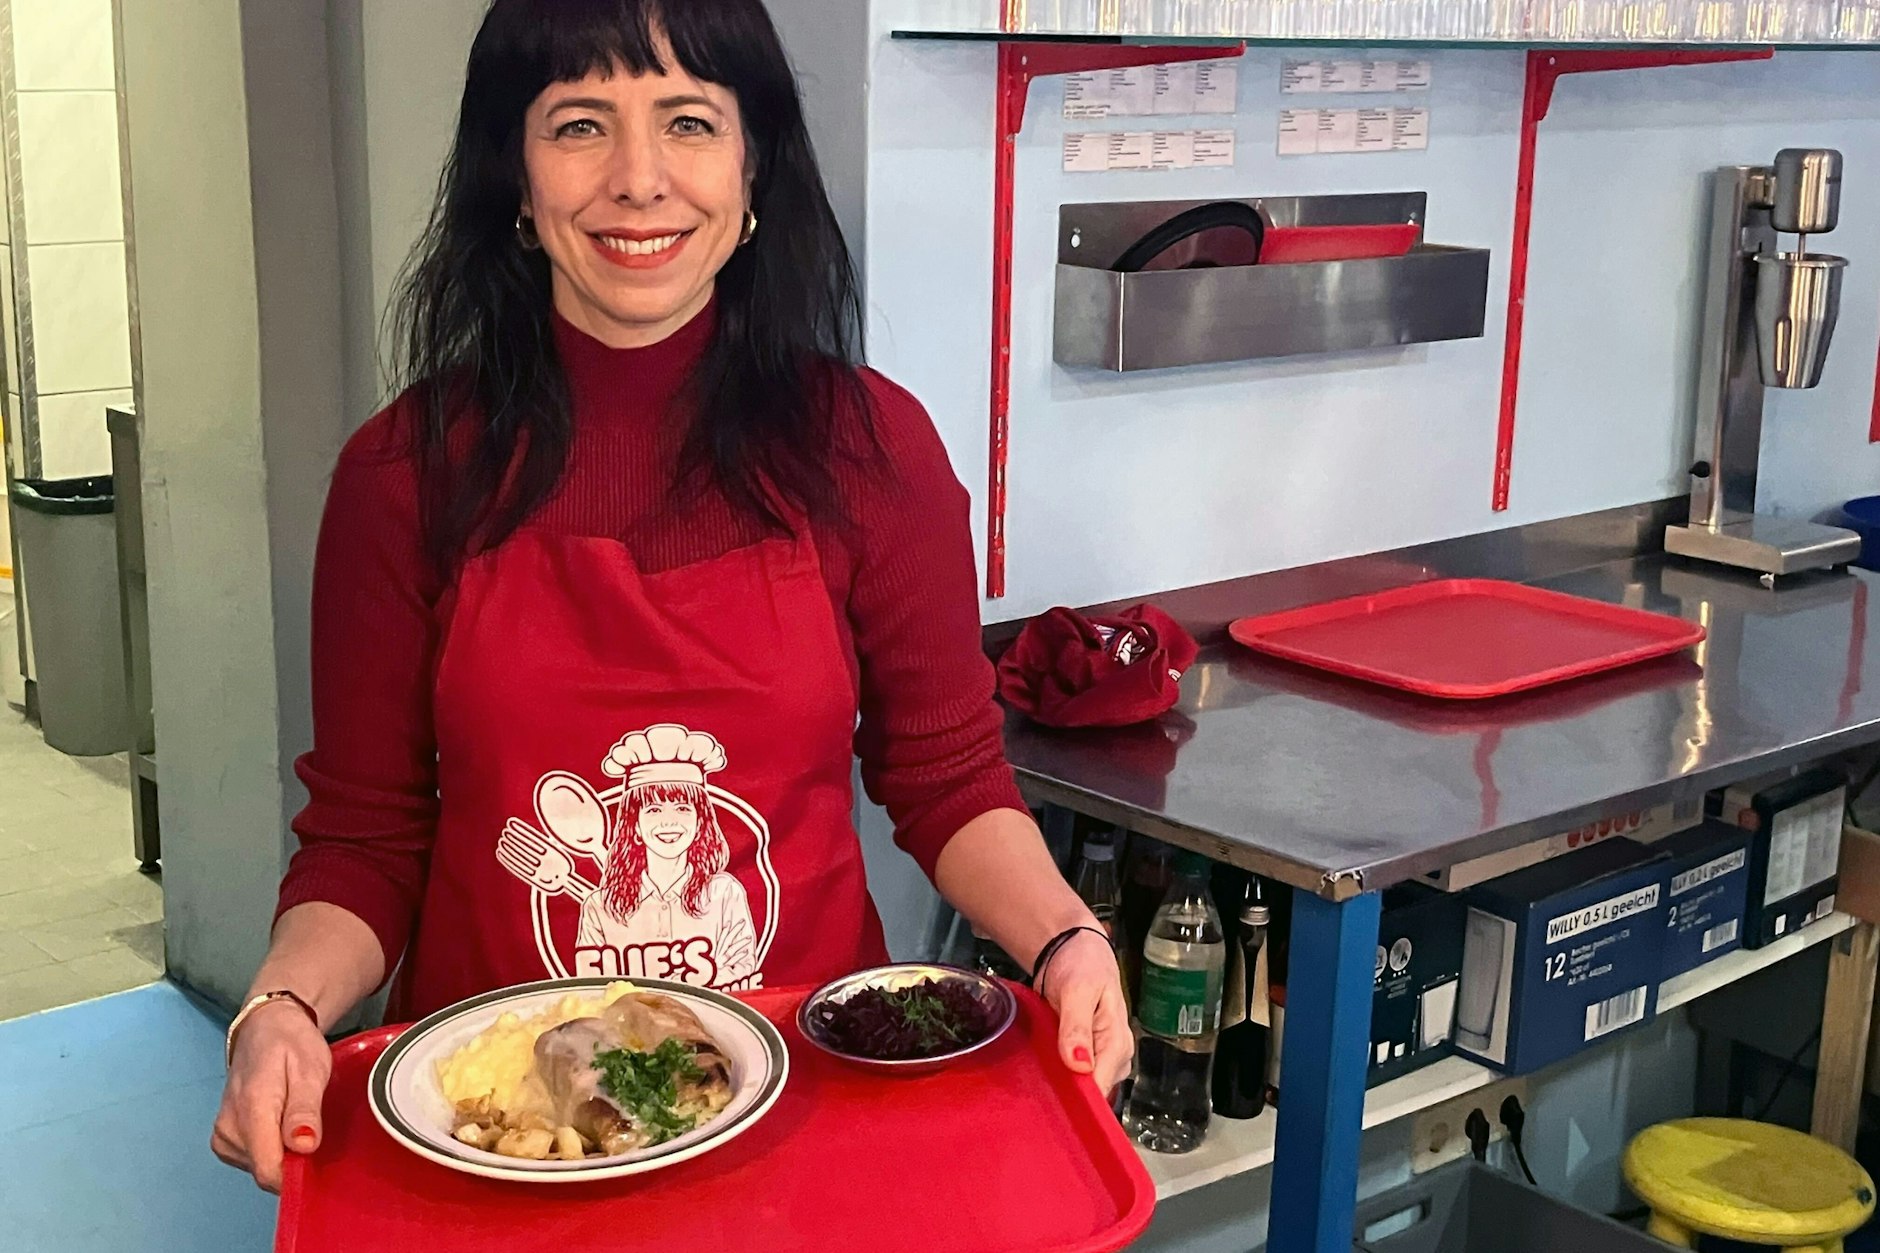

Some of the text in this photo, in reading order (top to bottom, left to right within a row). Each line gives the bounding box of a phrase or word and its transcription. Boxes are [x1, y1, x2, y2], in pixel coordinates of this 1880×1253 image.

[1549, 914, 1581, 938] WILLY
[1583, 908, 1600, 926] 0,5
[1602, 904, 1608, 919] L
[1611, 890, 1656, 919] geeicht
[1545, 952, 1566, 981] 12
